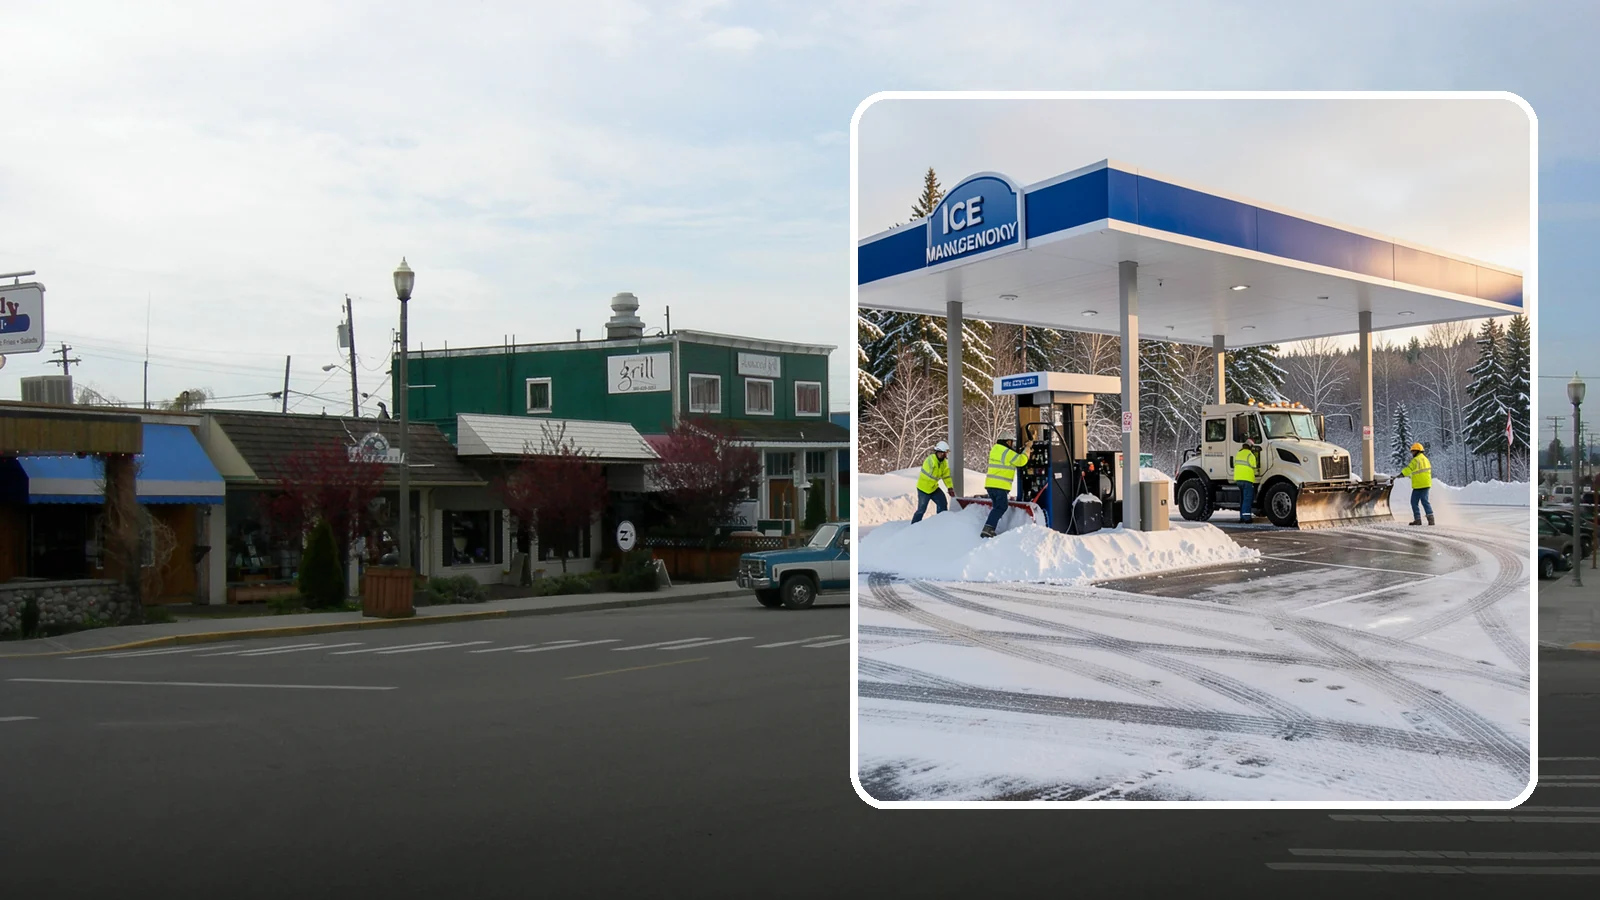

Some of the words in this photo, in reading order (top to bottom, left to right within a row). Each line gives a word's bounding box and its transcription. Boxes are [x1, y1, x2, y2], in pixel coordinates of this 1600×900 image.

[942, 196, 982, 235] ICE
[20, 336, 38, 345] Salads
[617, 356, 655, 392] grill
